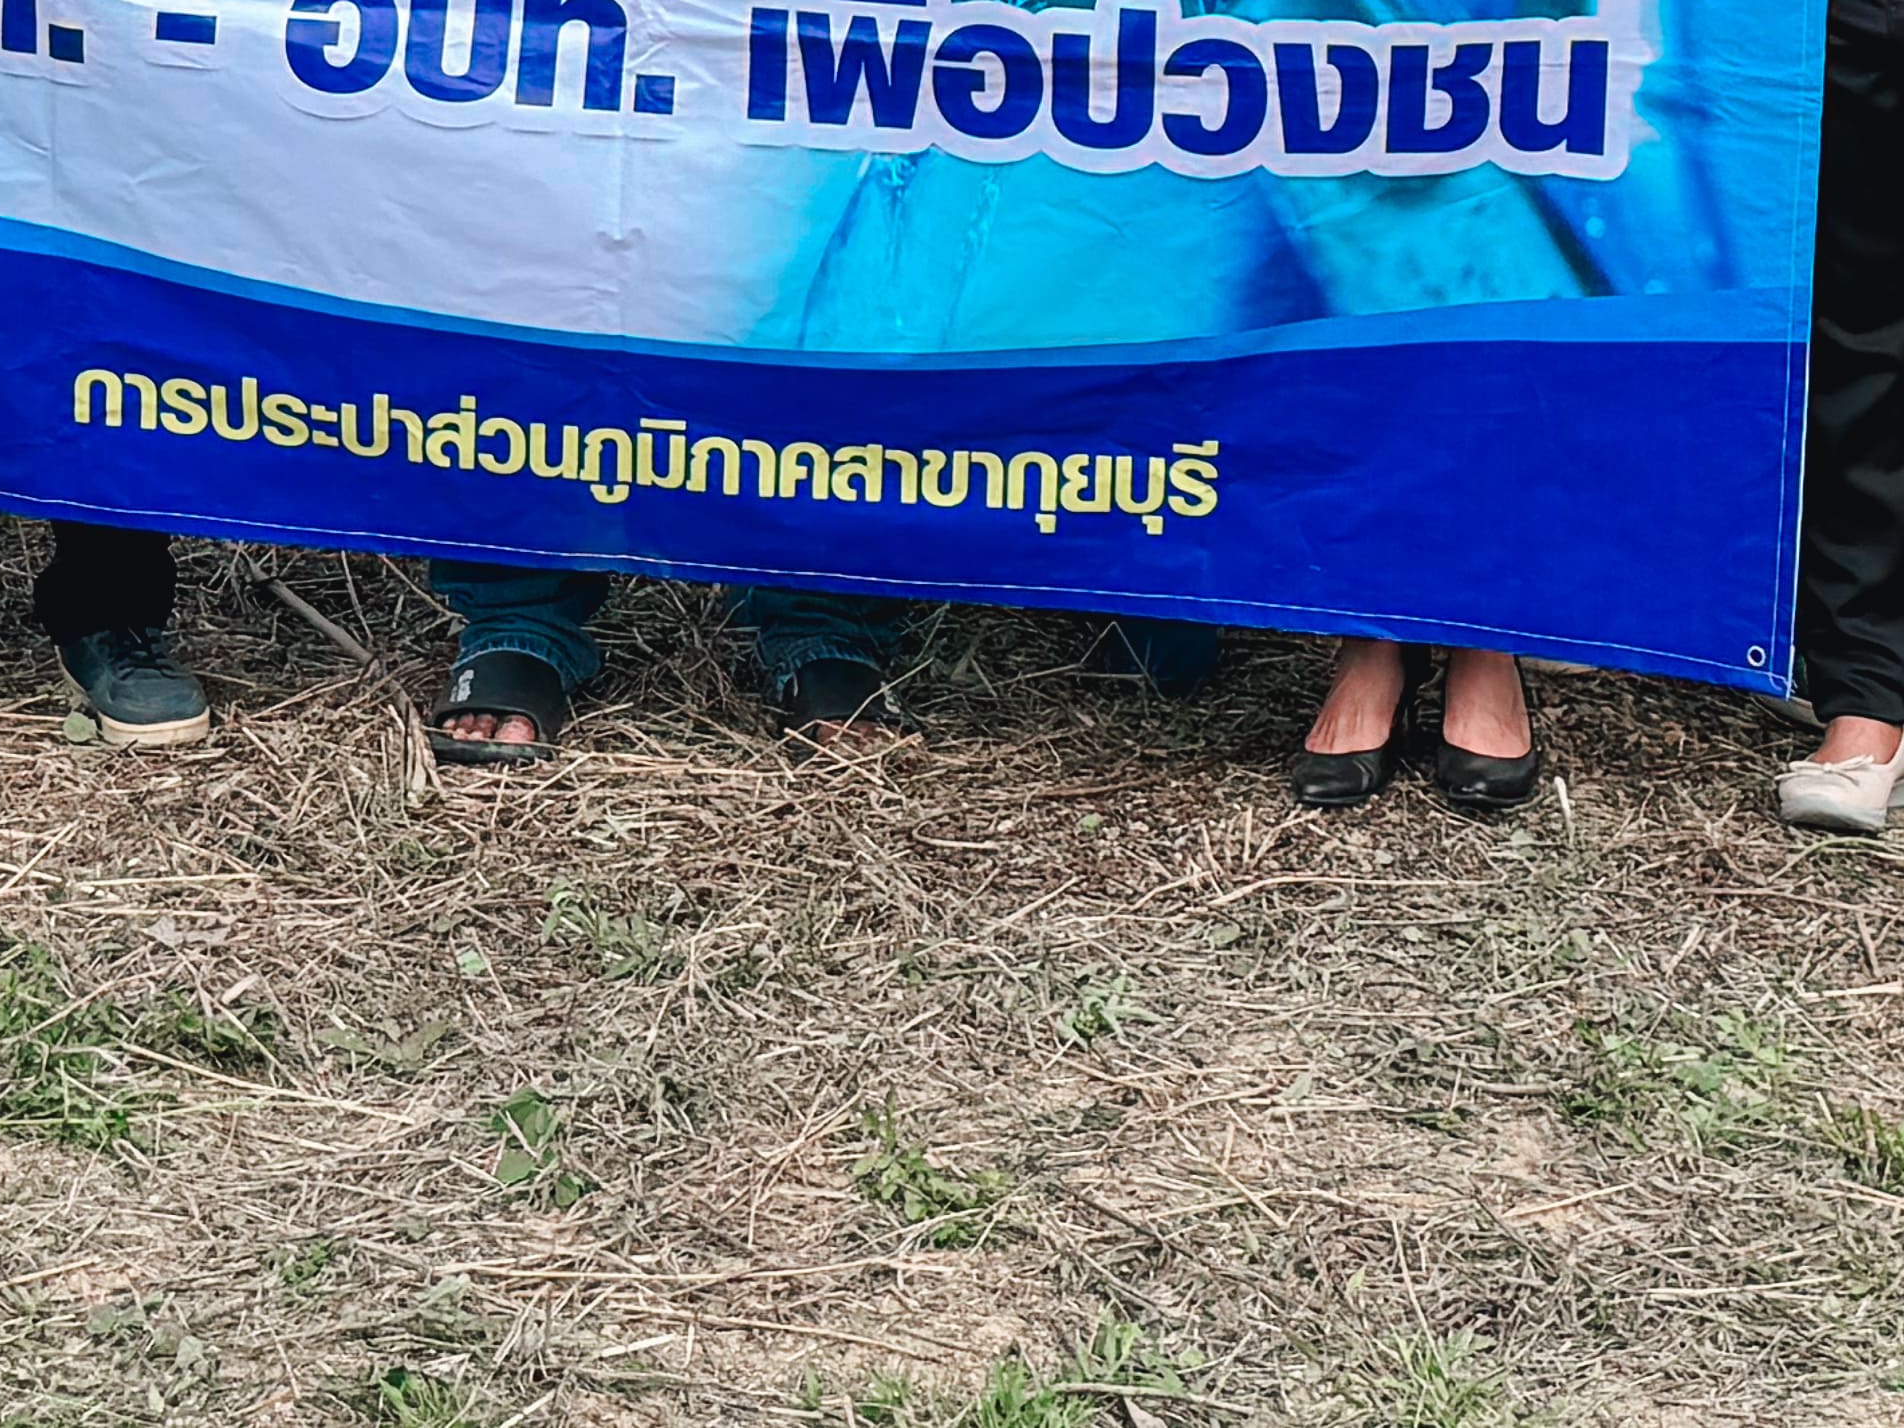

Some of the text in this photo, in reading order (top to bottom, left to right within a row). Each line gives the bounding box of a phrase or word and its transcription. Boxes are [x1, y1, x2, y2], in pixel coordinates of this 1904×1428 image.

[155, 10, 217, 45] -
[71, 365, 1220, 536] การประปาส่วนภูมิภาคสาขากุยบุรี
